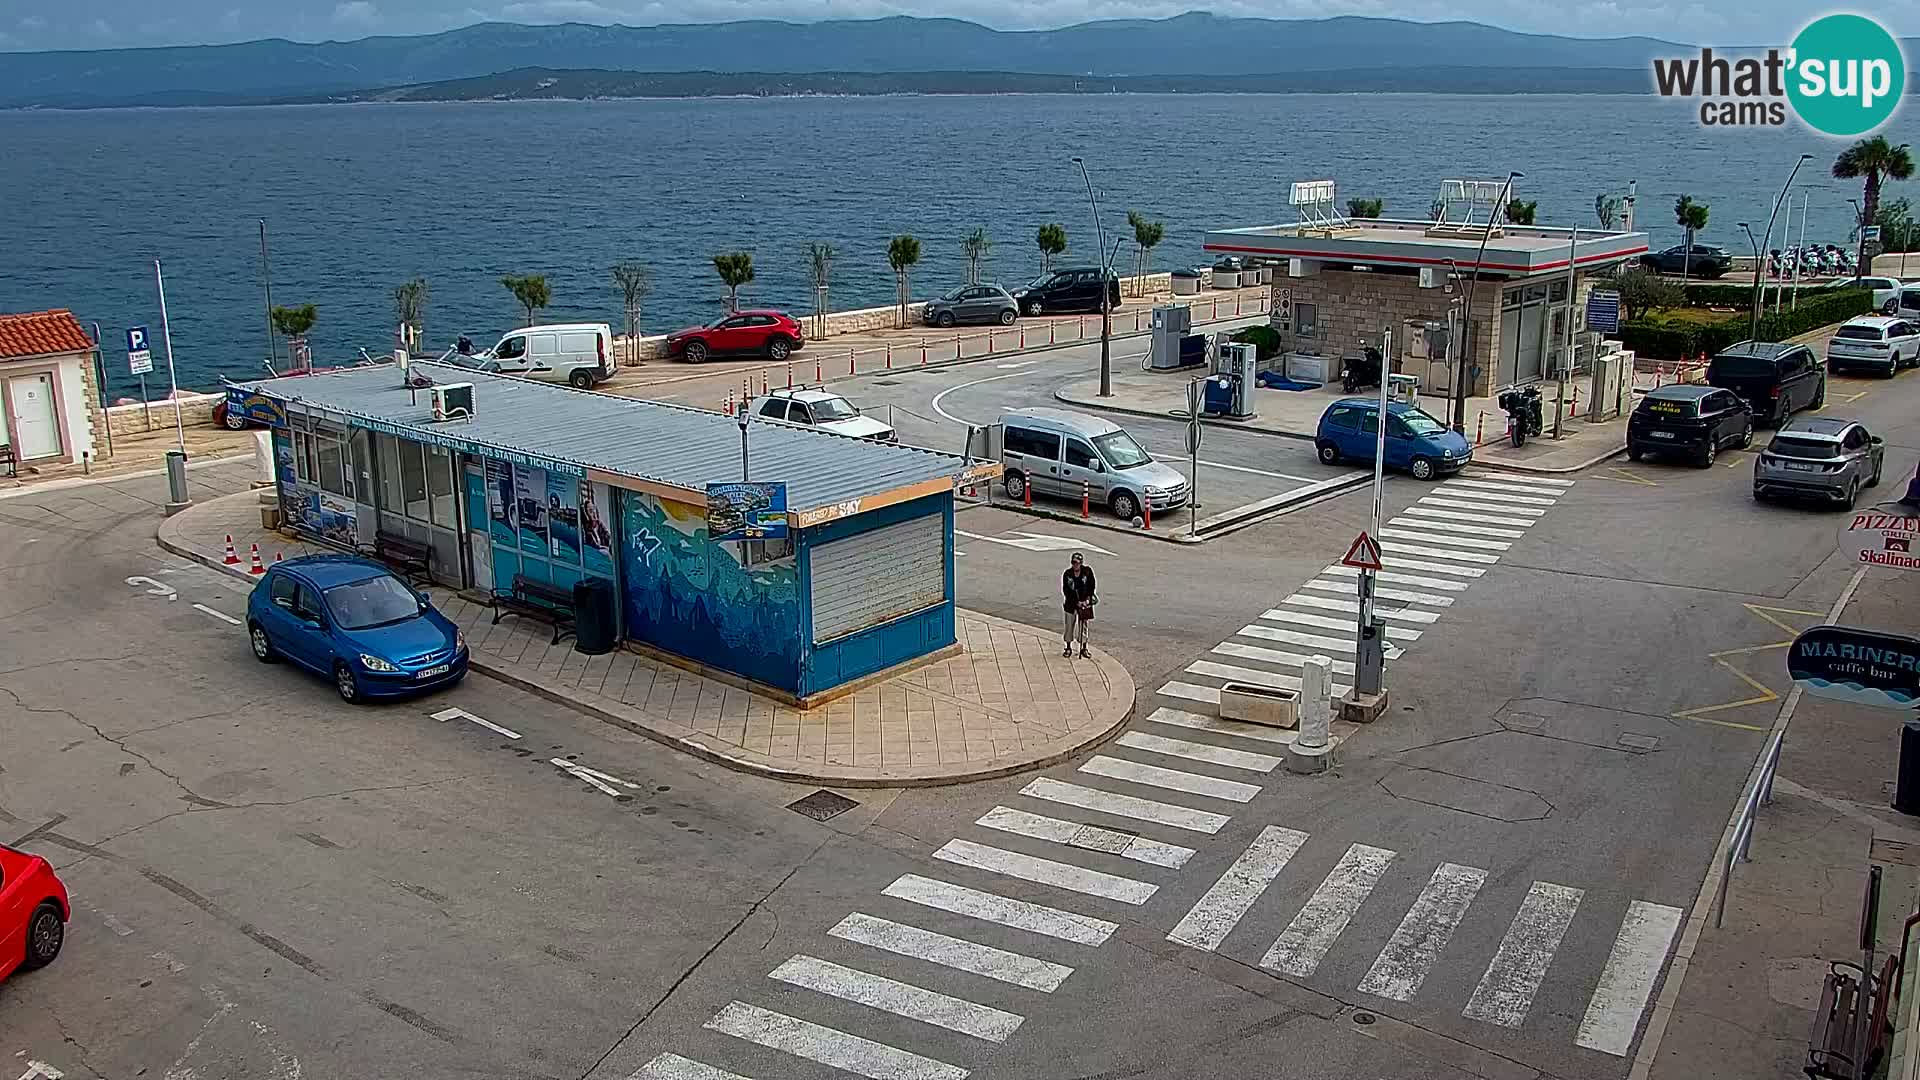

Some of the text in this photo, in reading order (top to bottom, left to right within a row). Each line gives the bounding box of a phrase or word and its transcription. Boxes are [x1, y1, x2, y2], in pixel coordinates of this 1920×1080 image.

[130, 331, 144, 349] P
[478, 445, 493, 457] BUS
[494, 449, 527, 464] STATION
[529, 456, 555, 470] TICKET
[556, 463, 583, 477] OFFICE
[1848, 515, 1920, 533] PIZZE
[1881, 530, 1917, 540] GRILL
[1828, 662, 1896, 679] caffe bar
